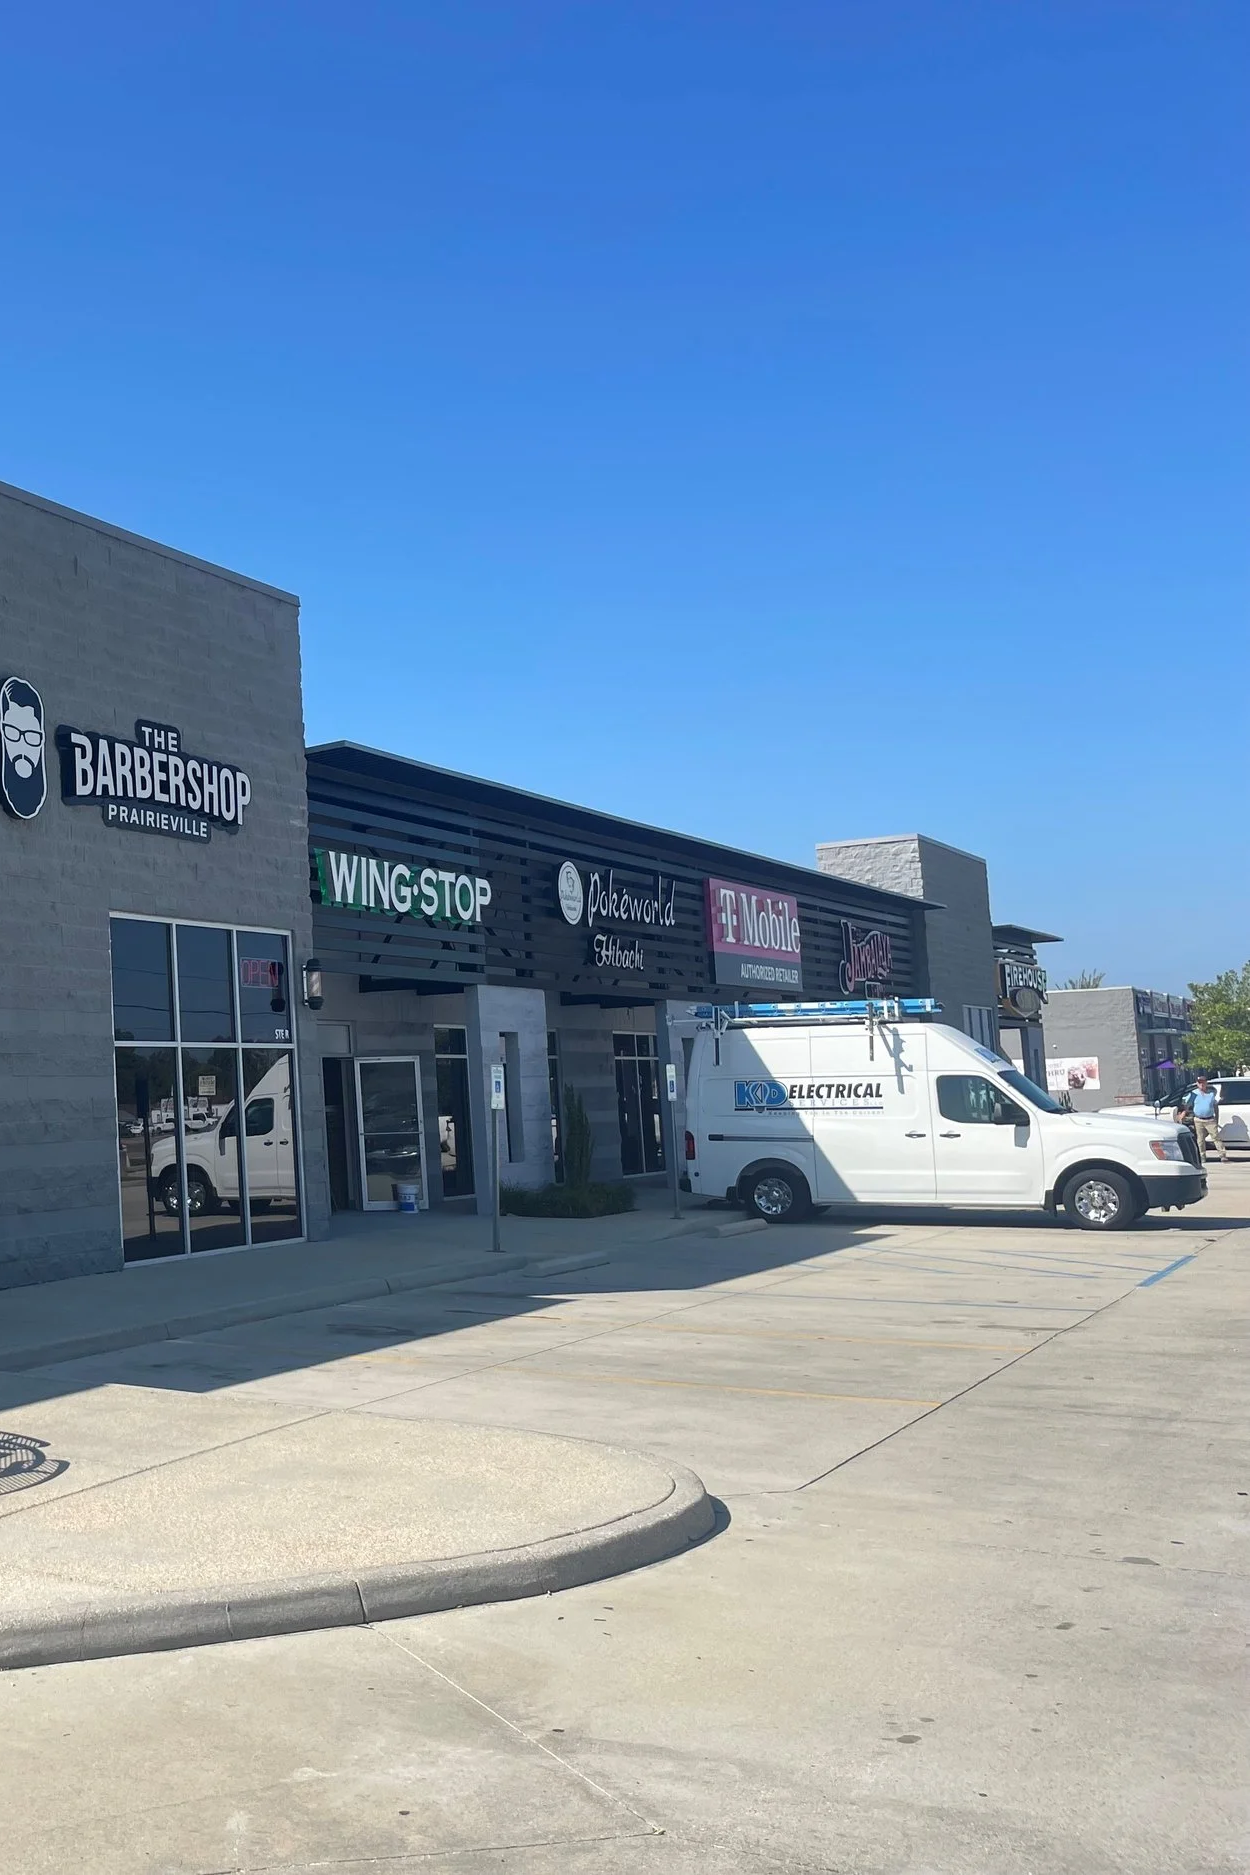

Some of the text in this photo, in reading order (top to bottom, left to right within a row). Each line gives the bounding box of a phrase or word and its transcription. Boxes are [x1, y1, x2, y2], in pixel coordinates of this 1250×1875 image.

[141, 726, 178, 752] THE
[71, 732, 251, 825] BARBERSHOP
[108, 804, 207, 838] PRAIRIEVILLE
[594, 934, 644, 970] Hibachi
[241, 960, 278, 987] OPEN
[741, 963, 799, 984] AUTHORIZED RETAILER
[1004, 964, 1048, 1001] FIREHOUSE
[1046, 1069, 1065, 1077] HRU
[789, 1083, 883, 1099] ELECTRICAL
[789, 1099, 870, 1107] SERVICES
